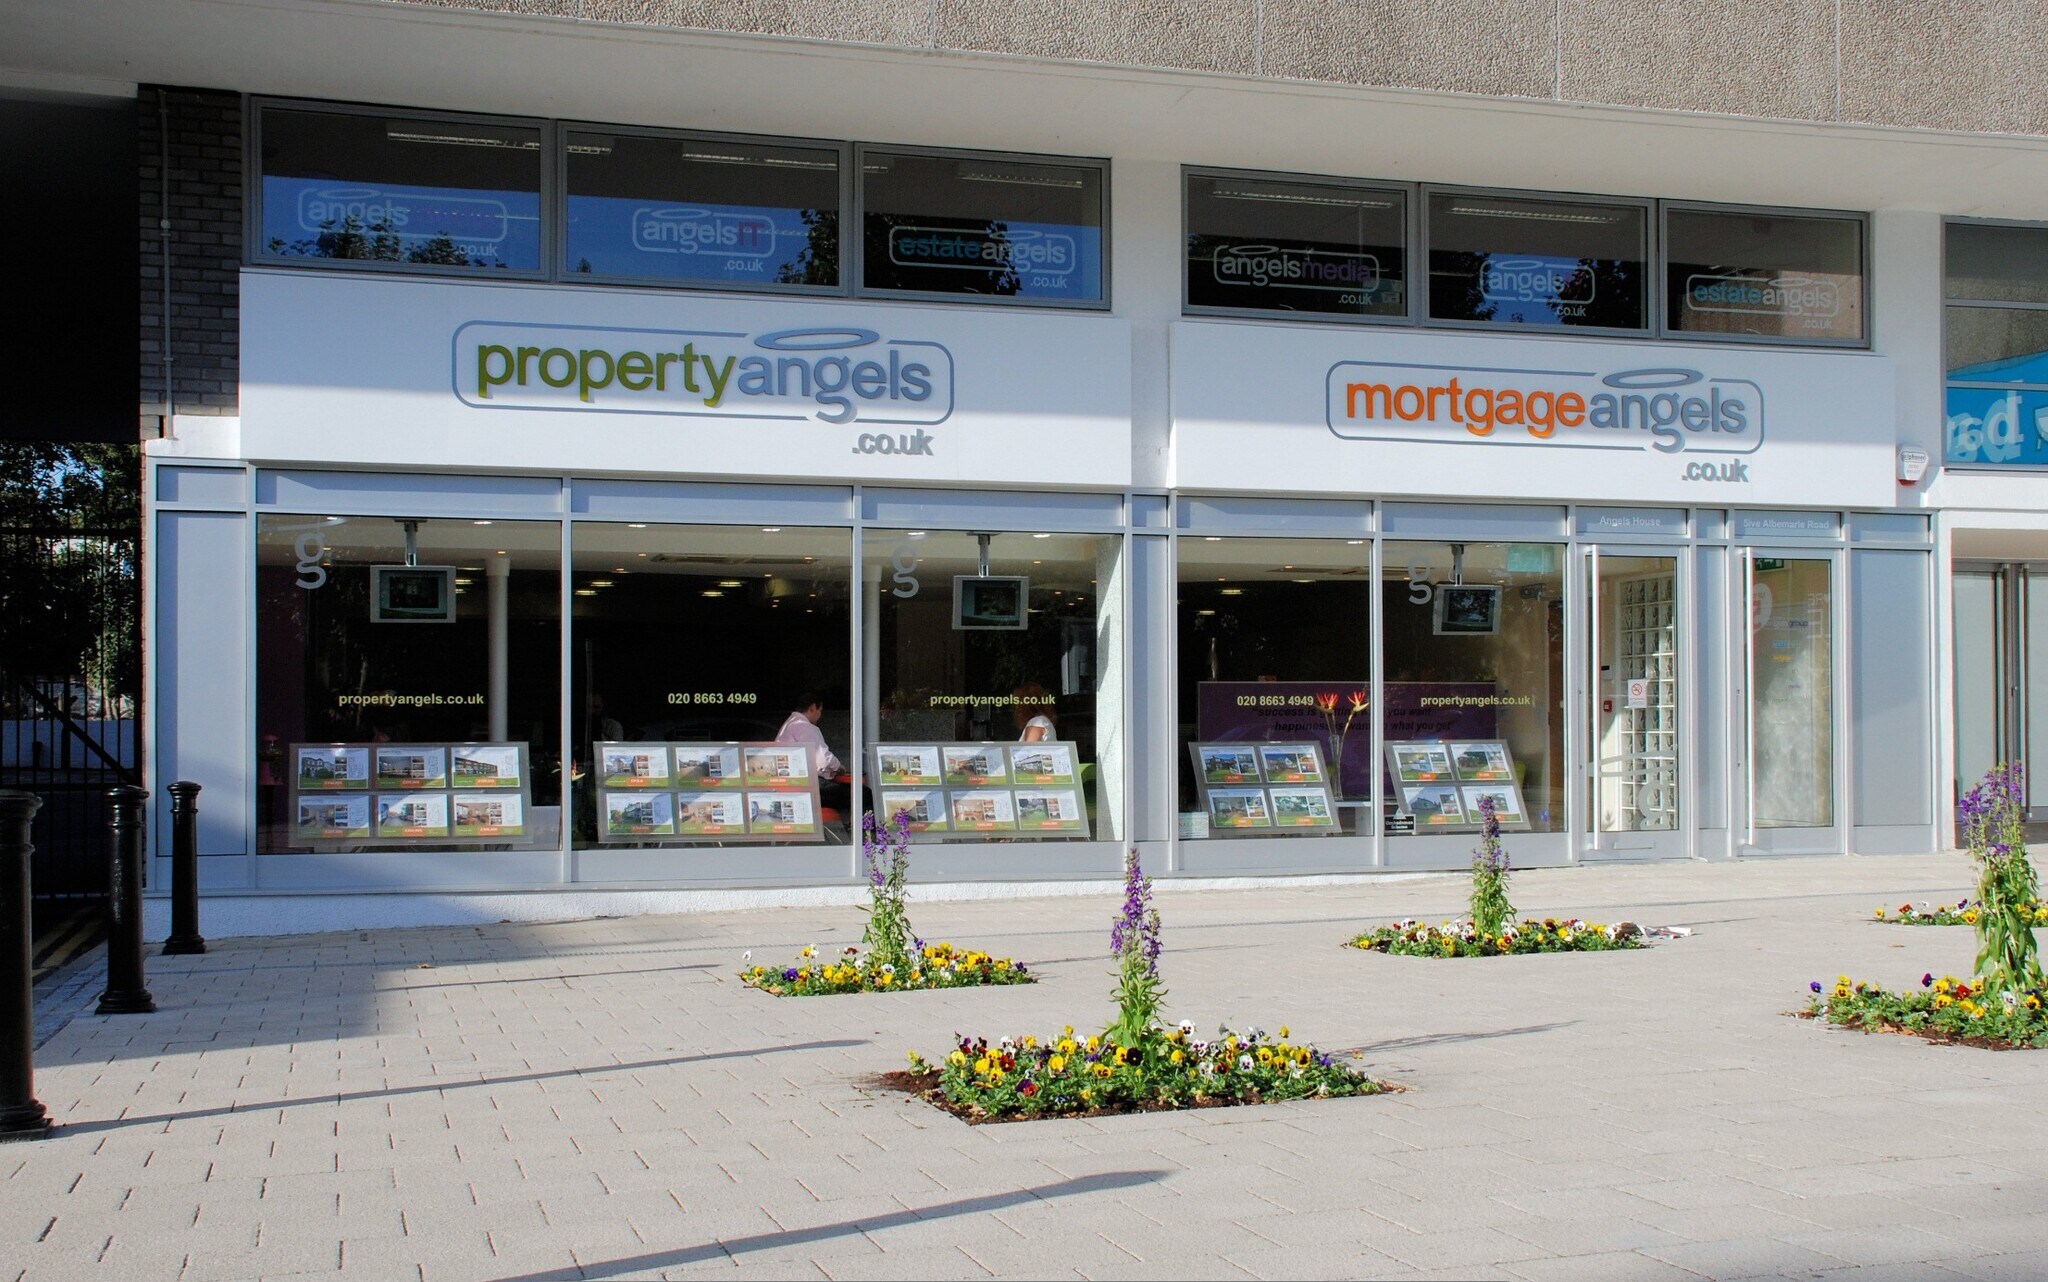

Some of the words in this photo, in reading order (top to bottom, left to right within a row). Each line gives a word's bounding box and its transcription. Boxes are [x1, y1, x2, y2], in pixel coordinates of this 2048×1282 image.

[899, 234, 1066, 272] estateangels
[723, 258, 764, 272] .co.uk
[1220, 253, 1371, 286] angelsmedia
[1030, 275, 1068, 289] .co.uk
[1338, 293, 1373, 306] .co.uk
[1694, 280, 1832, 316] estateangels
[1801, 318, 1833, 330] .co.uk
[477, 341, 934, 424] propertyangels
[1346, 377, 1748, 454] mortgageangels
[852, 428, 935, 456] .co.uk
[1681, 458, 1749, 483] .co.uk
[1600, 515, 1630, 527] Angels
[1632, 516, 1661, 527] House
[1763, 519, 1805, 529] Albemarle
[1807, 520, 1830, 530] Road
[338, 693, 484, 707] propertyangels.co.uk
[667, 693, 691, 705] 020
[693, 693, 724, 705] 8663
[726, 693, 757, 705] 4949
[930, 694, 1056, 707] propertyangels.co.uk
[1236, 695, 1257, 706] 020
[1259, 695, 1285, 706] 8663
[1288, 695, 1314, 706] 4949
[1420, 695, 1531, 708] propertyangels.co.uk
[1307, 707, 1316, 716] is
[1388, 708, 1406, 718] you
[1408, 707, 1432, 716] want
[1391, 720, 1414, 730] what
[1416, 723, 1434, 733] you
